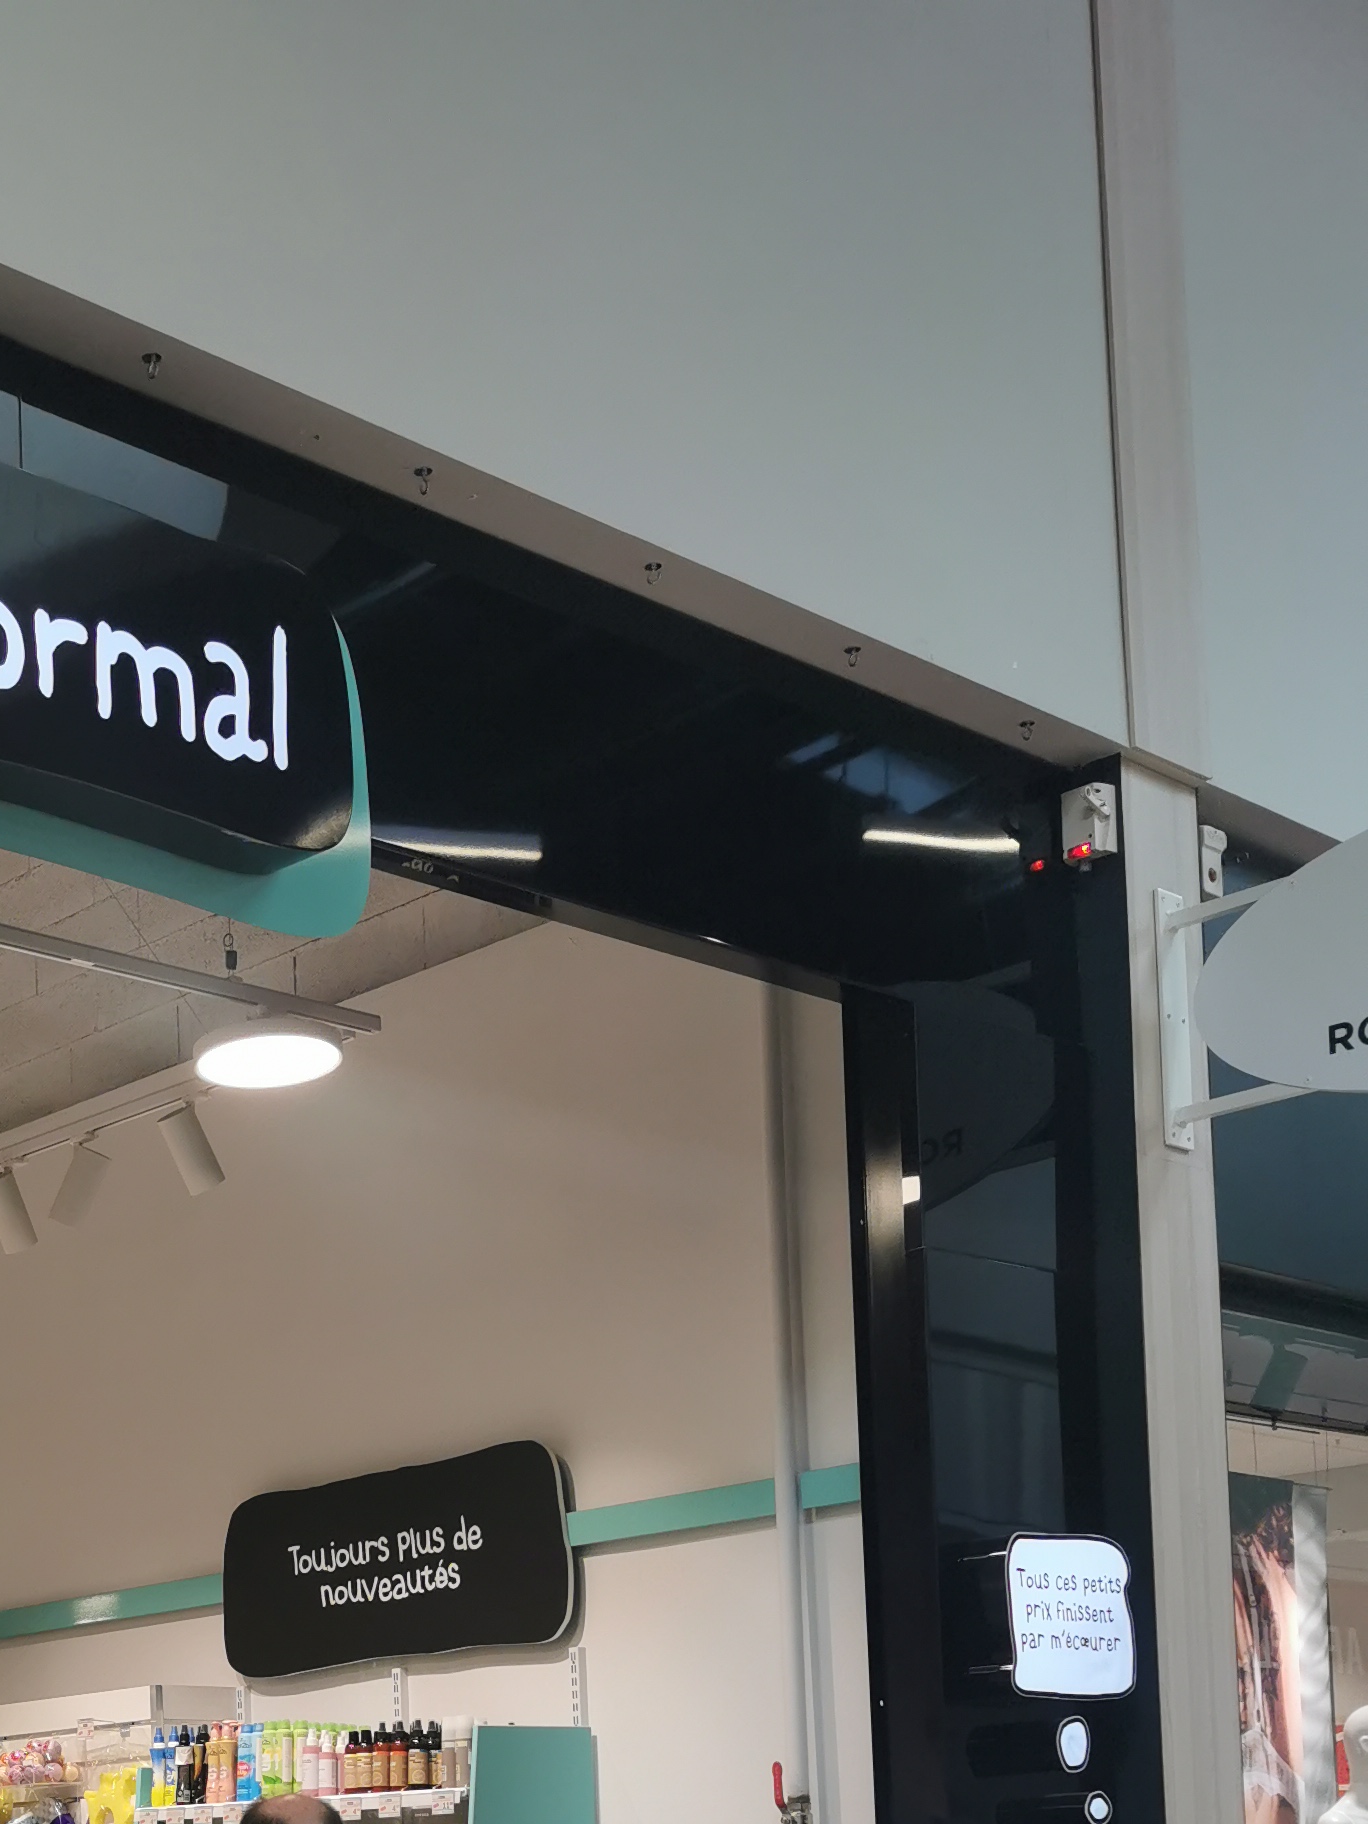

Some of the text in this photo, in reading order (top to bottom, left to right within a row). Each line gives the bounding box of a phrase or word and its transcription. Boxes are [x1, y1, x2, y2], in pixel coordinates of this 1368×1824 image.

[288, 1515, 483, 1576] Toujours plus de
[320, 1559, 462, 1608] nouveautés
[1016, 1567, 1122, 1596] Tous ces petits
[1026, 1600, 1115, 1625] prix finissent
[1021, 1631, 1045, 1653] par
